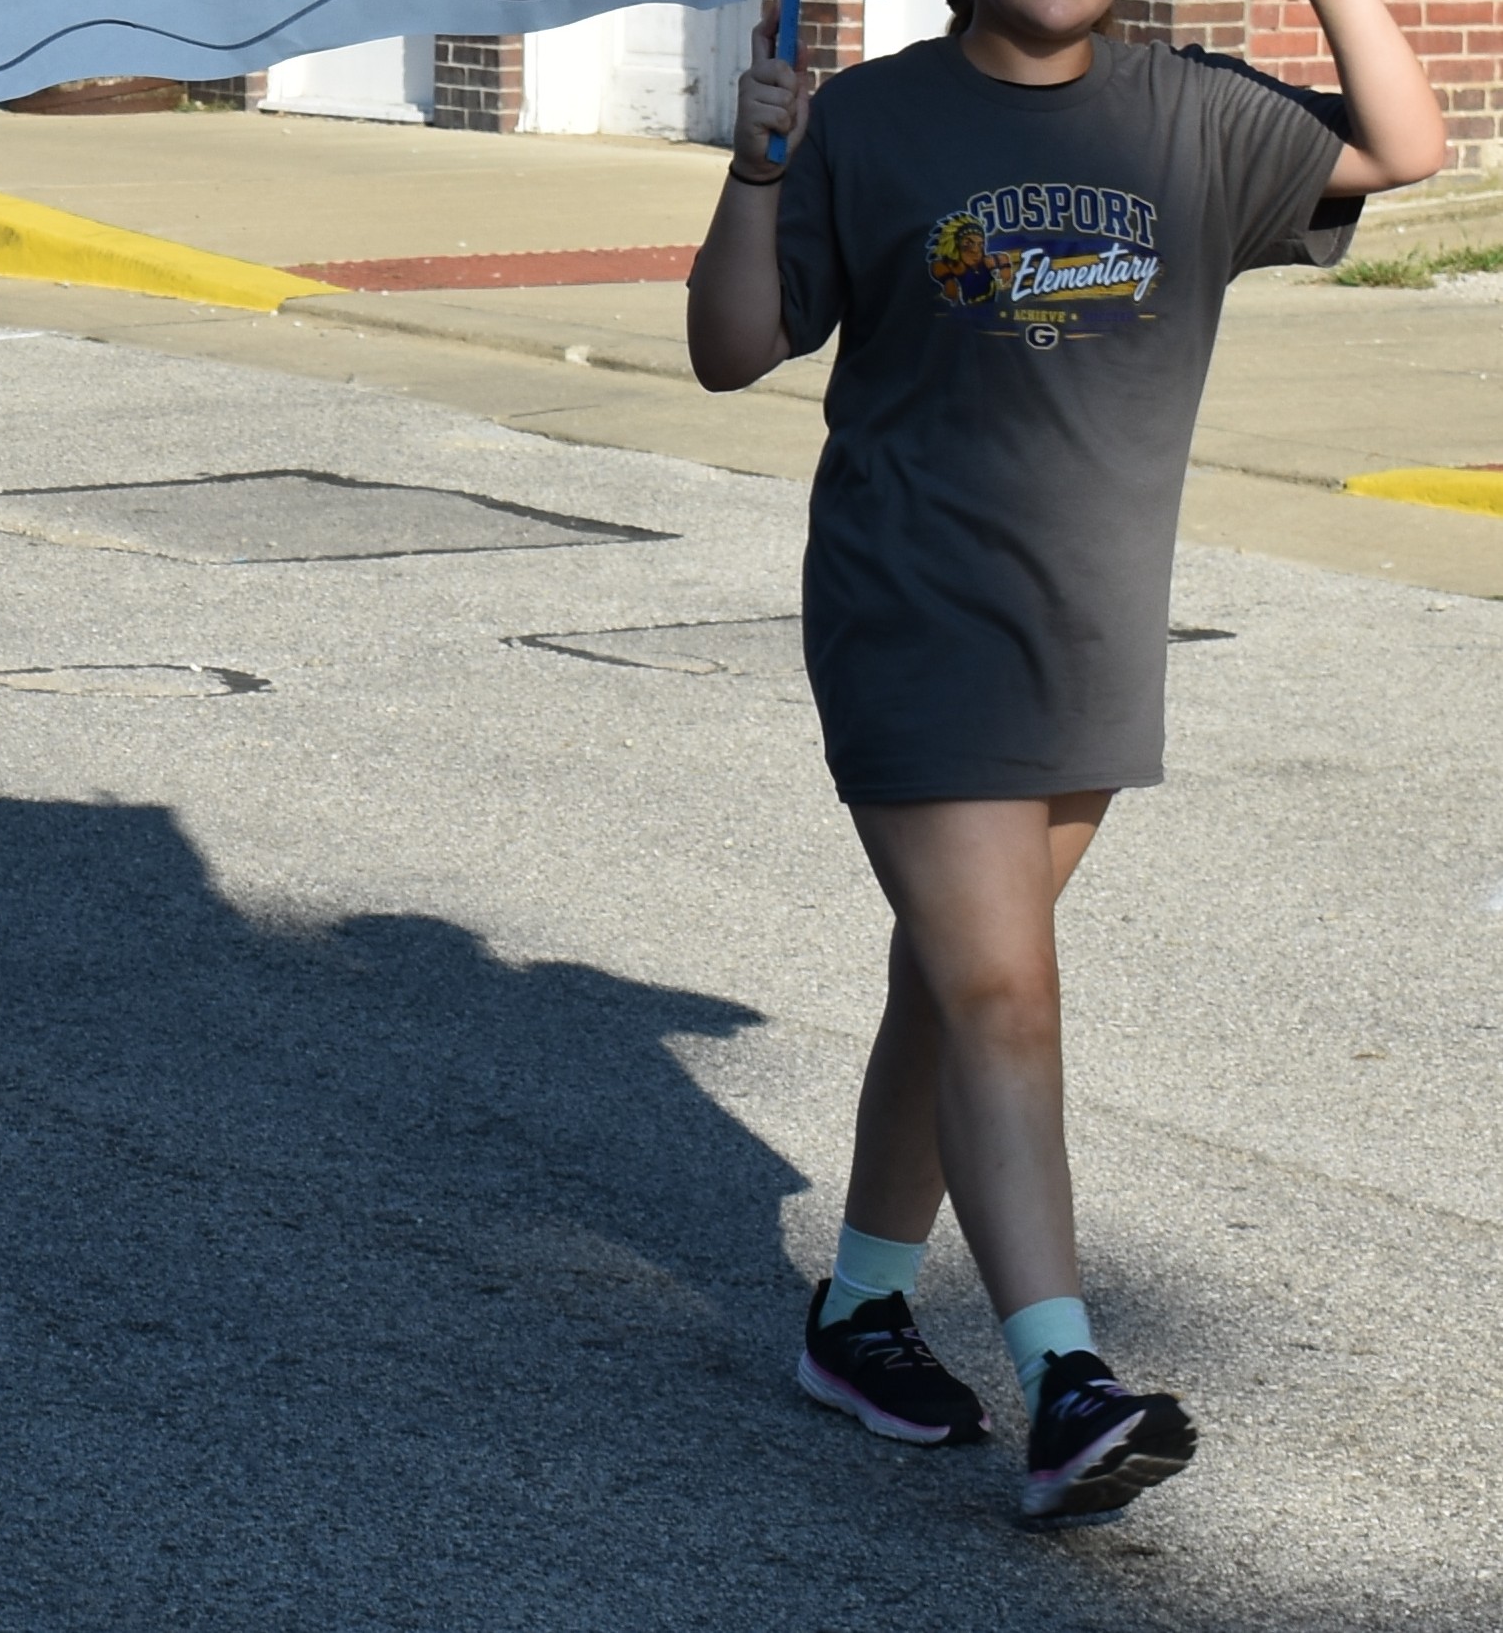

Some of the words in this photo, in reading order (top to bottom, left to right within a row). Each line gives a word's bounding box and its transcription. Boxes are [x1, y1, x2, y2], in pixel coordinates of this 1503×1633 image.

[966, 183, 1158, 248] GOSPORT
[1010, 242, 1159, 302] Elementary
[1012, 309, 1066, 323] ACHIEVE
[1025, 323, 1059, 350] G
